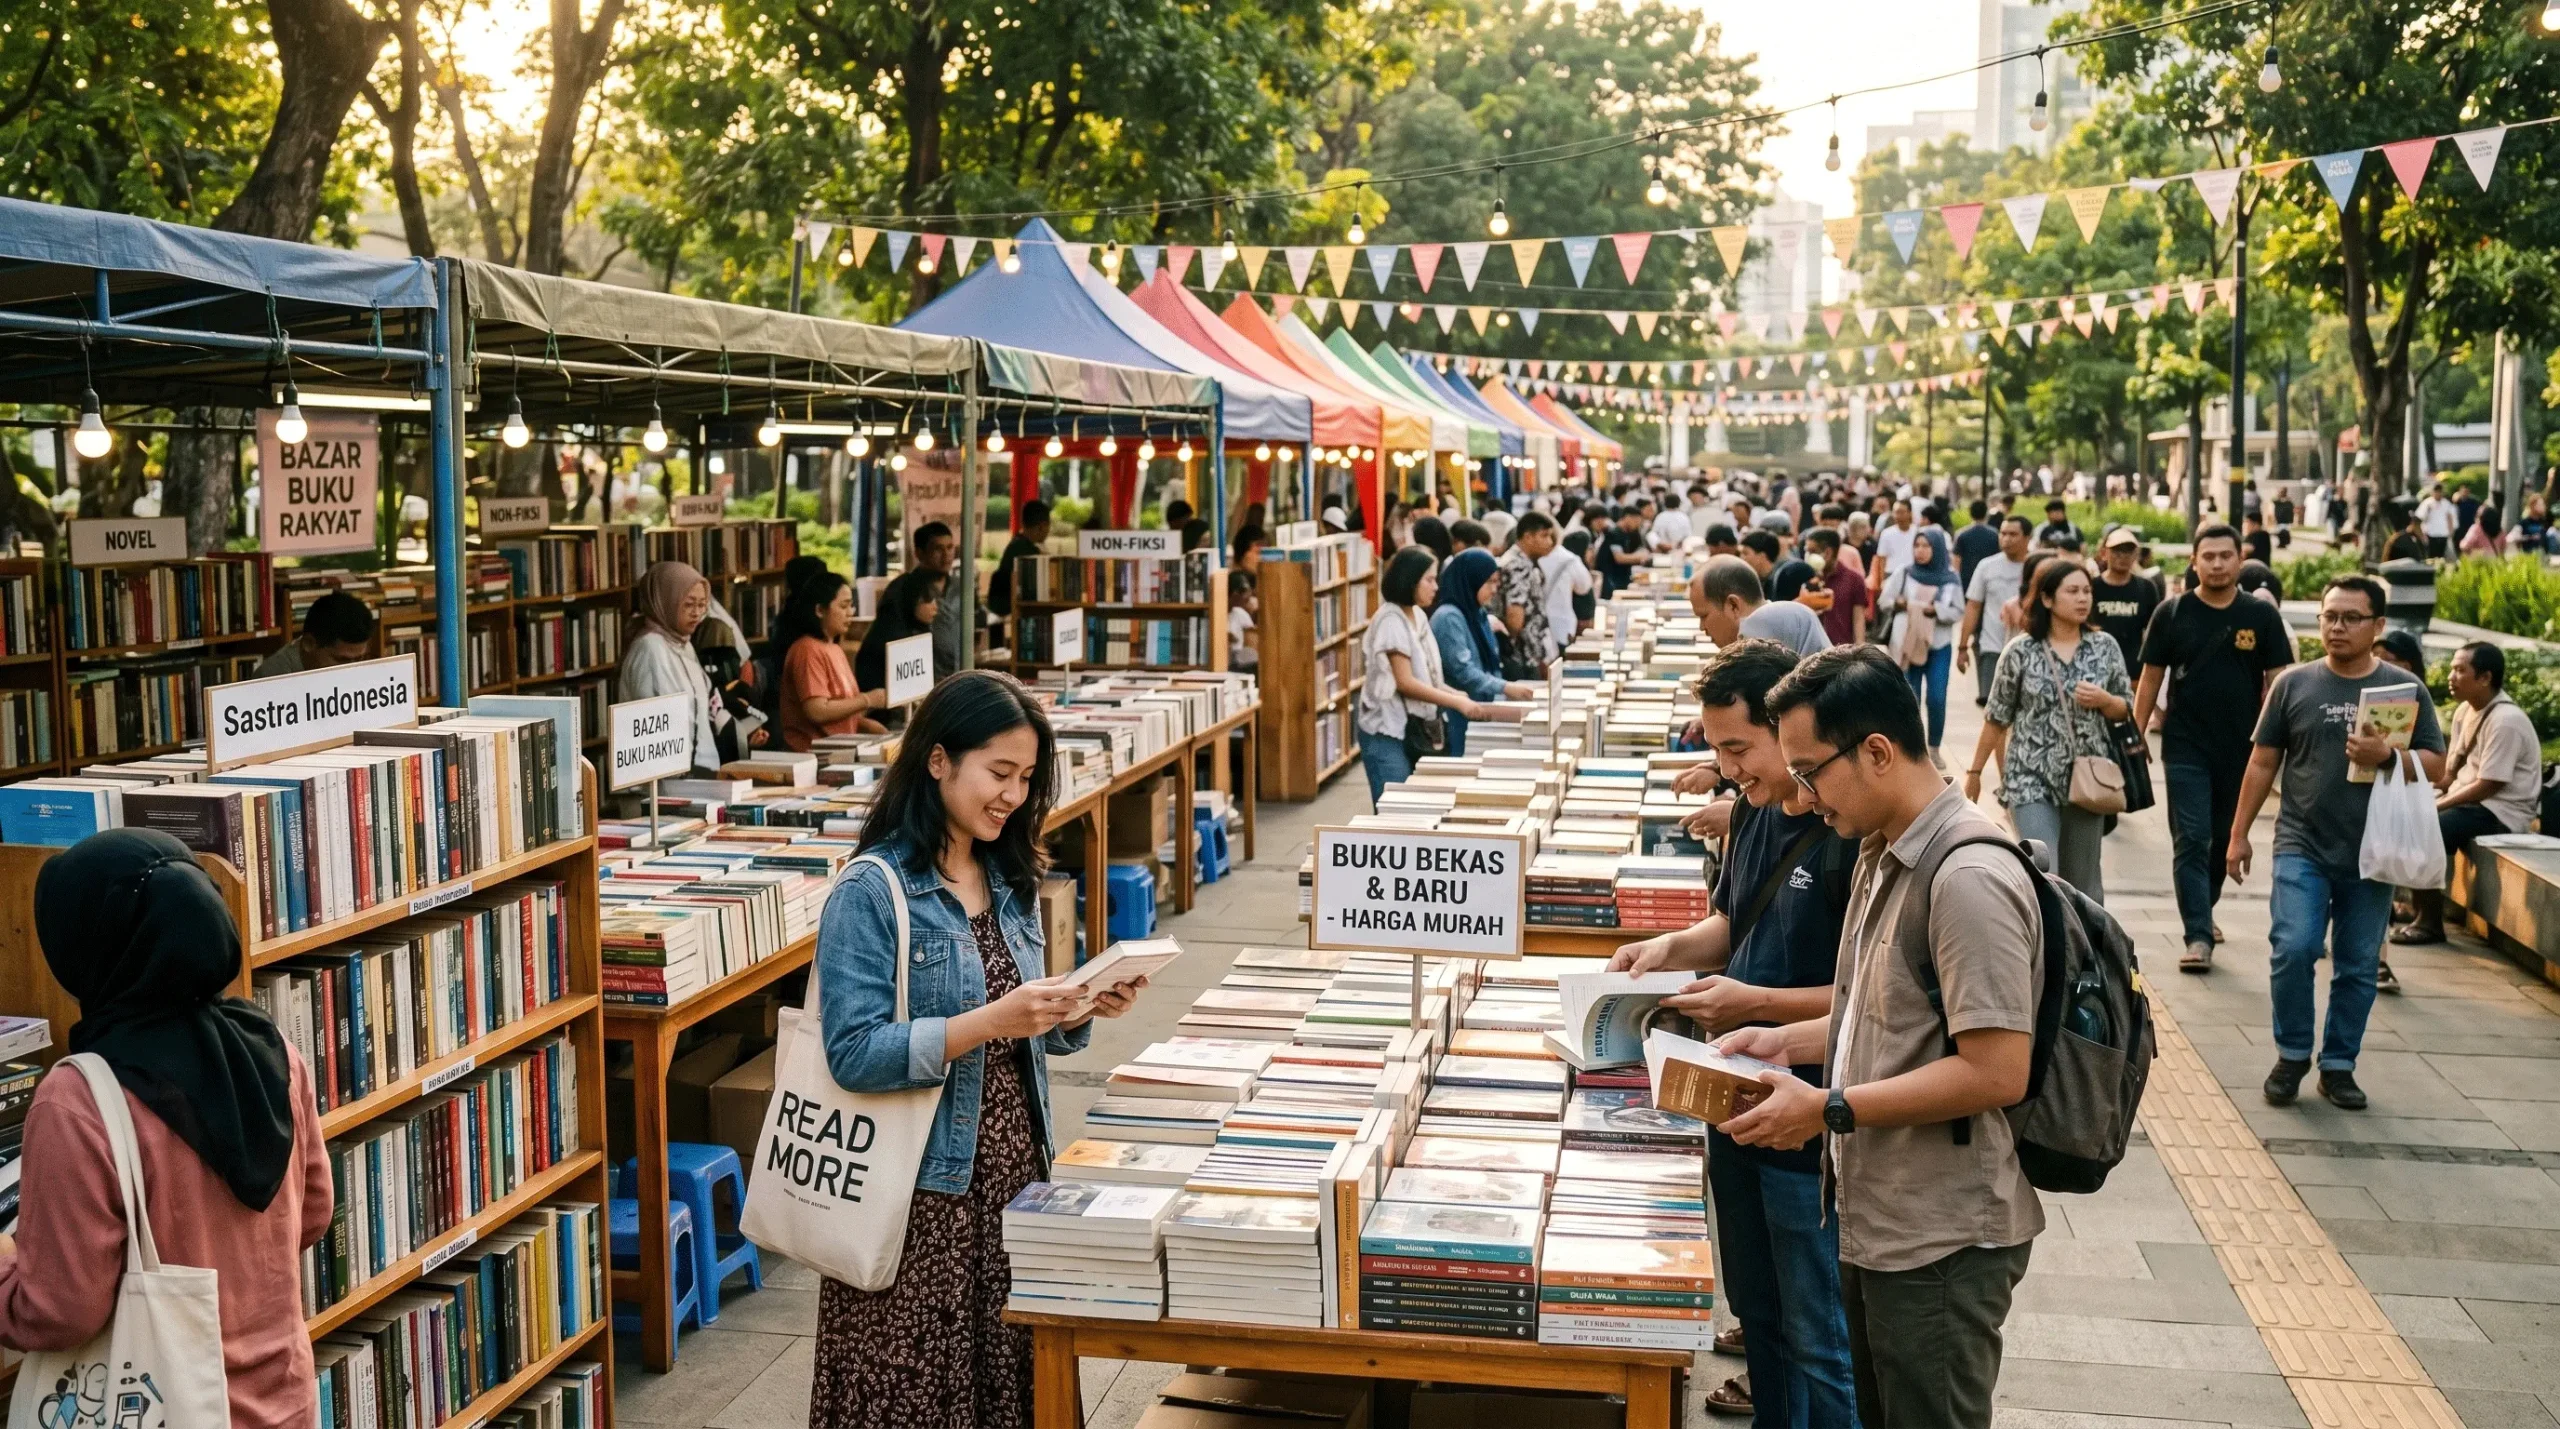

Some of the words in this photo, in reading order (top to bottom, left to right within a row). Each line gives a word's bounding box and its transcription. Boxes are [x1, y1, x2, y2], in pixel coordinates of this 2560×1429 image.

[280, 442, 361, 469] BAZAR
[288, 476, 354, 505] BUKU
[280, 509, 361, 538] RAKYAT
[105, 530, 156, 550] NOVEL
[1091, 537, 1165, 550] NON-FIKSI
[896, 658, 925, 681] NOVEL
[224, 701, 298, 737] Sastra
[305, 676, 408, 722] Indonesia
[633, 713, 669, 737] BAZAR
[617, 745, 645, 768] BUKU
[1332, 843, 1407, 870] BUKU
[1416, 847, 1504, 875] BEKAS
[1366, 876, 1385, 900] &
[1394, 877, 1468, 904] BARU
[1342, 908, 1416, 931] HARGA
[1423, 912, 1503, 936] MURAH
[777, 1090, 875, 1153] READ
[767, 1134, 869, 1203] MORE
